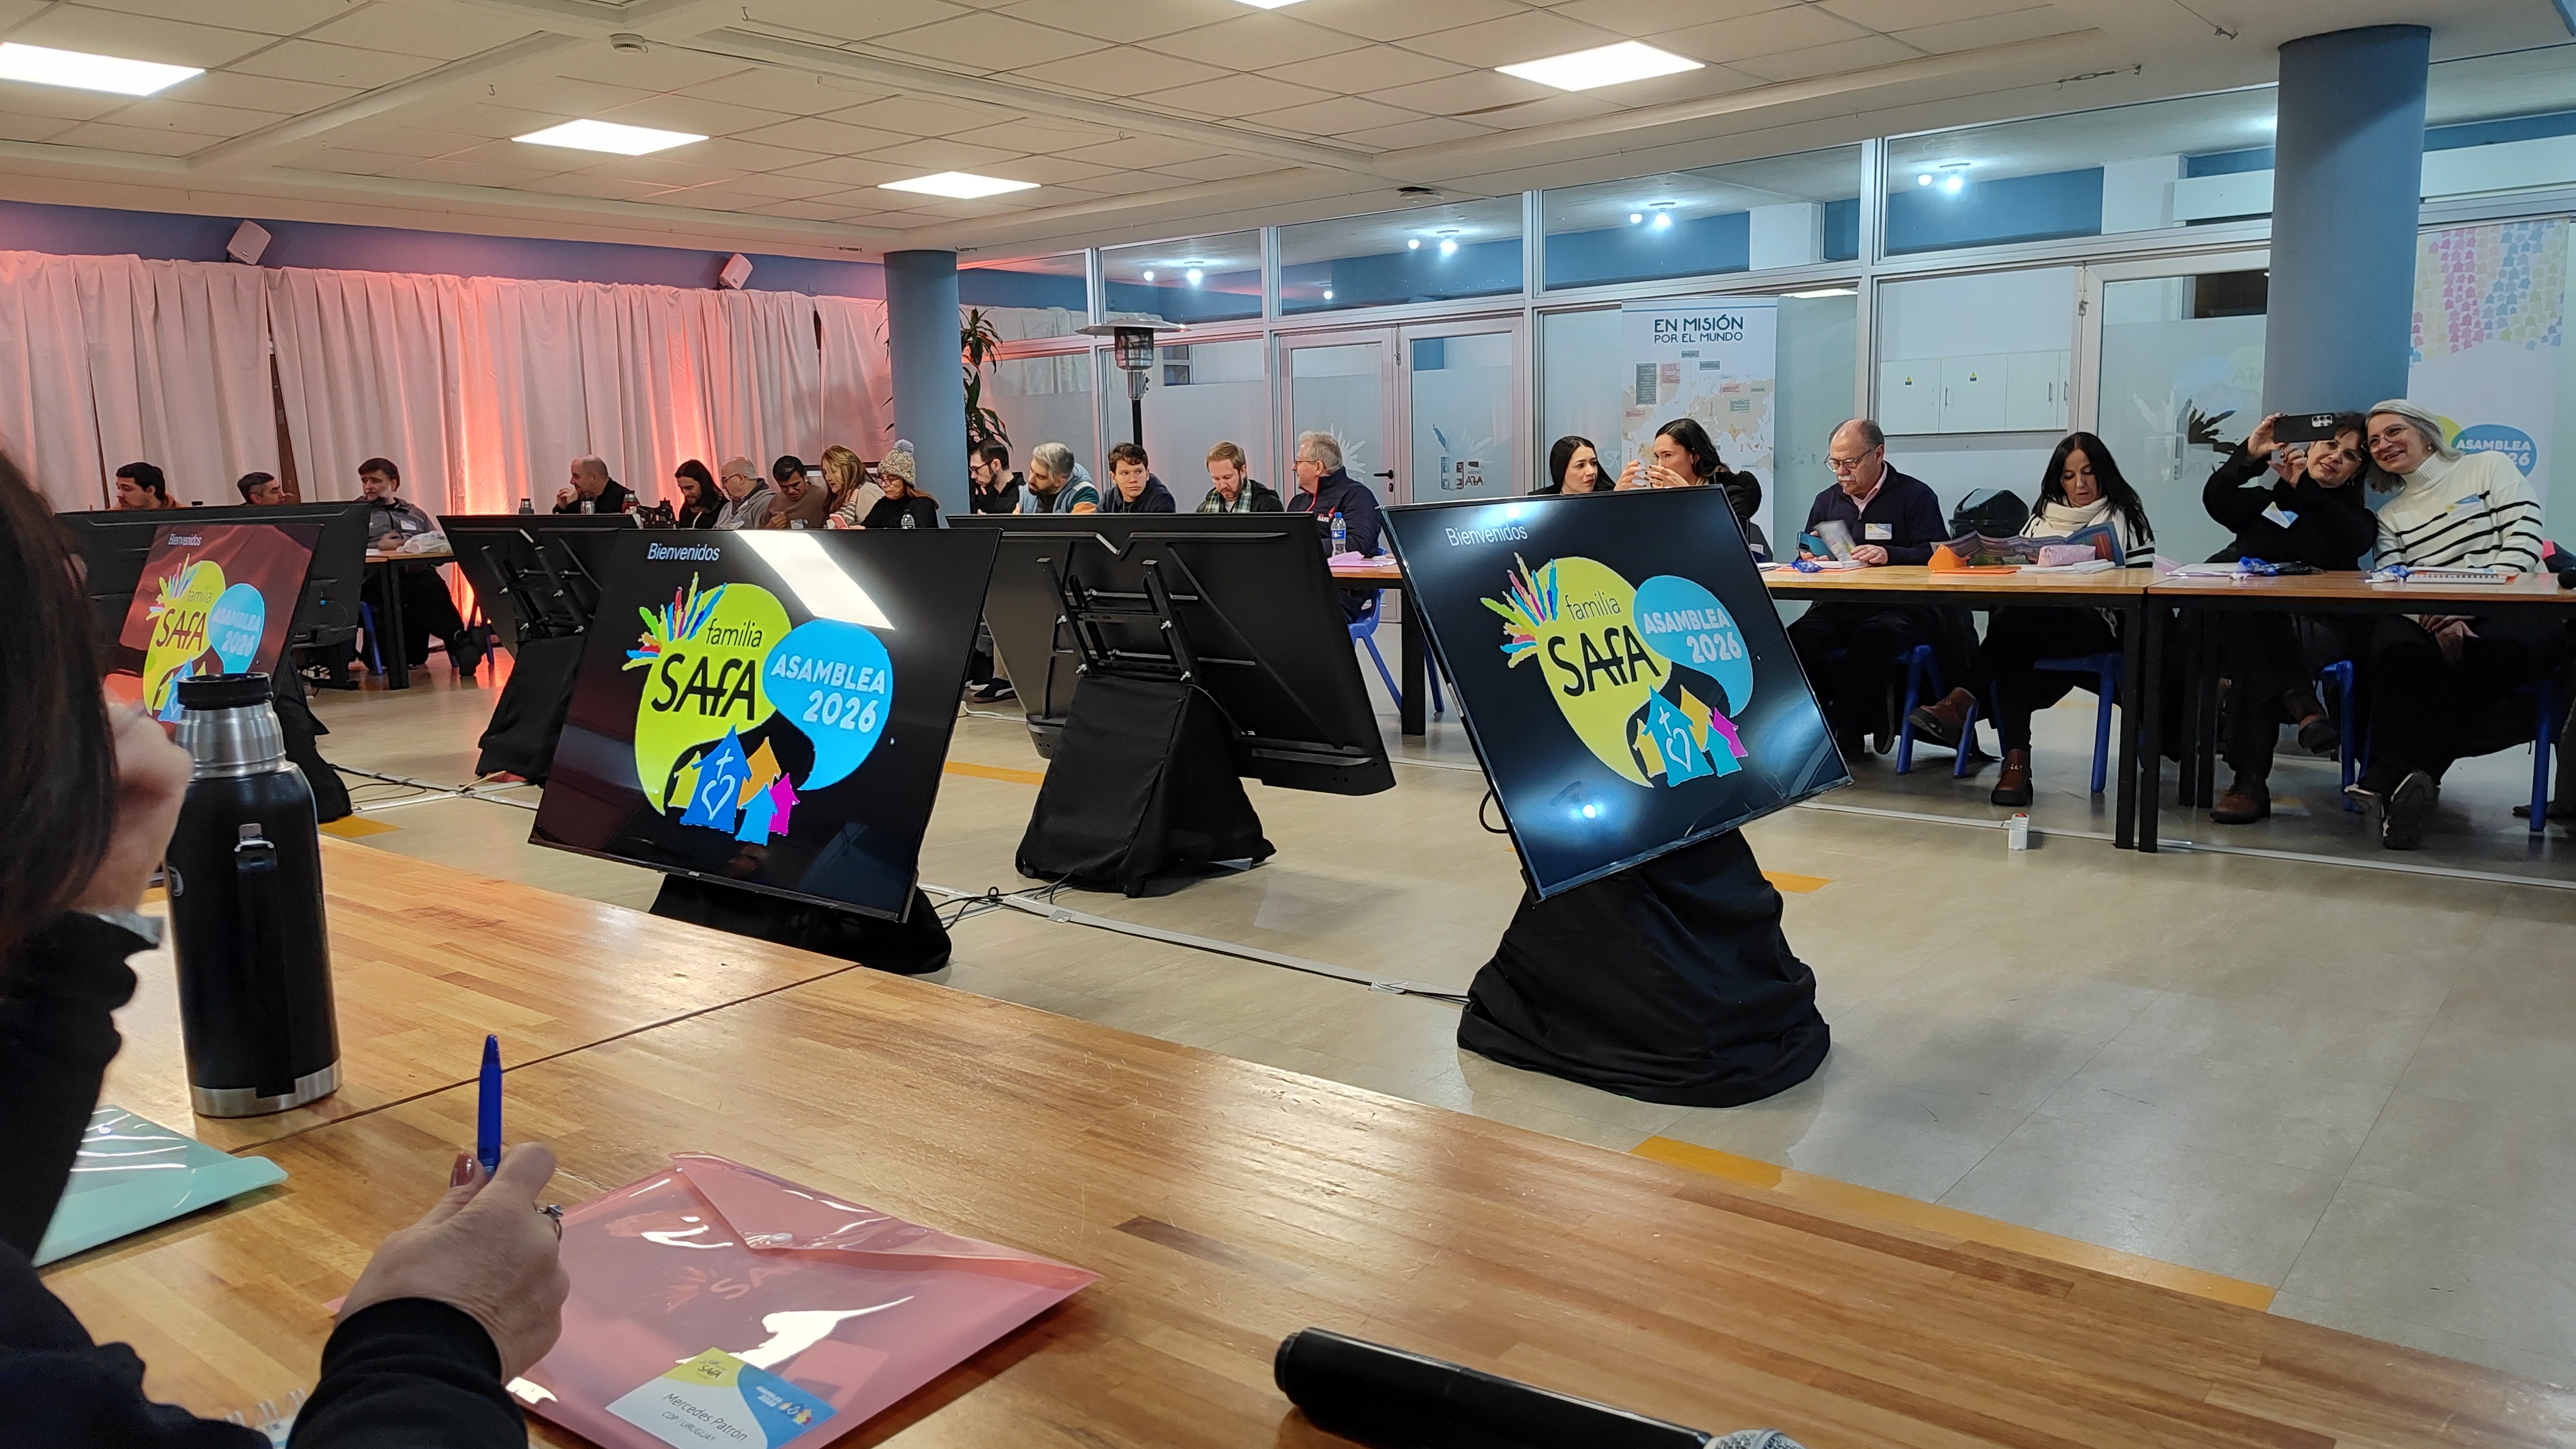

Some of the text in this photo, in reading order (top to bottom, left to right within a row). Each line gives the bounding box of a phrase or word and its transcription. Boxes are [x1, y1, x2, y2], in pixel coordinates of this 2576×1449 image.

[1654, 314, 1743, 333] EN MISIÓN
[1654, 331, 1743, 343] POR EL MUNDO
[2456, 439, 2531, 452] ASAMBLEA
[168, 533, 203, 547] Bienvenidos
[1445, 523, 1528, 547] Bienvenidos
[647, 543, 721, 562] Bienvenidos
[187, 586, 213, 604] familia
[1565, 591, 1622, 621] familia
[706, 619, 762, 647] familia
[1643, 608, 1731, 635] ASAMBLEA
[221, 630, 256, 657] 2026
[1687, 632, 1742, 663] 2026
[770, 653, 886, 695] ASAMBLEA
[802, 690, 879, 733] 2026
[662, 1392, 748, 1441] Mercedes Patrón
[680, 1421, 717, 1441] URUGUAY
